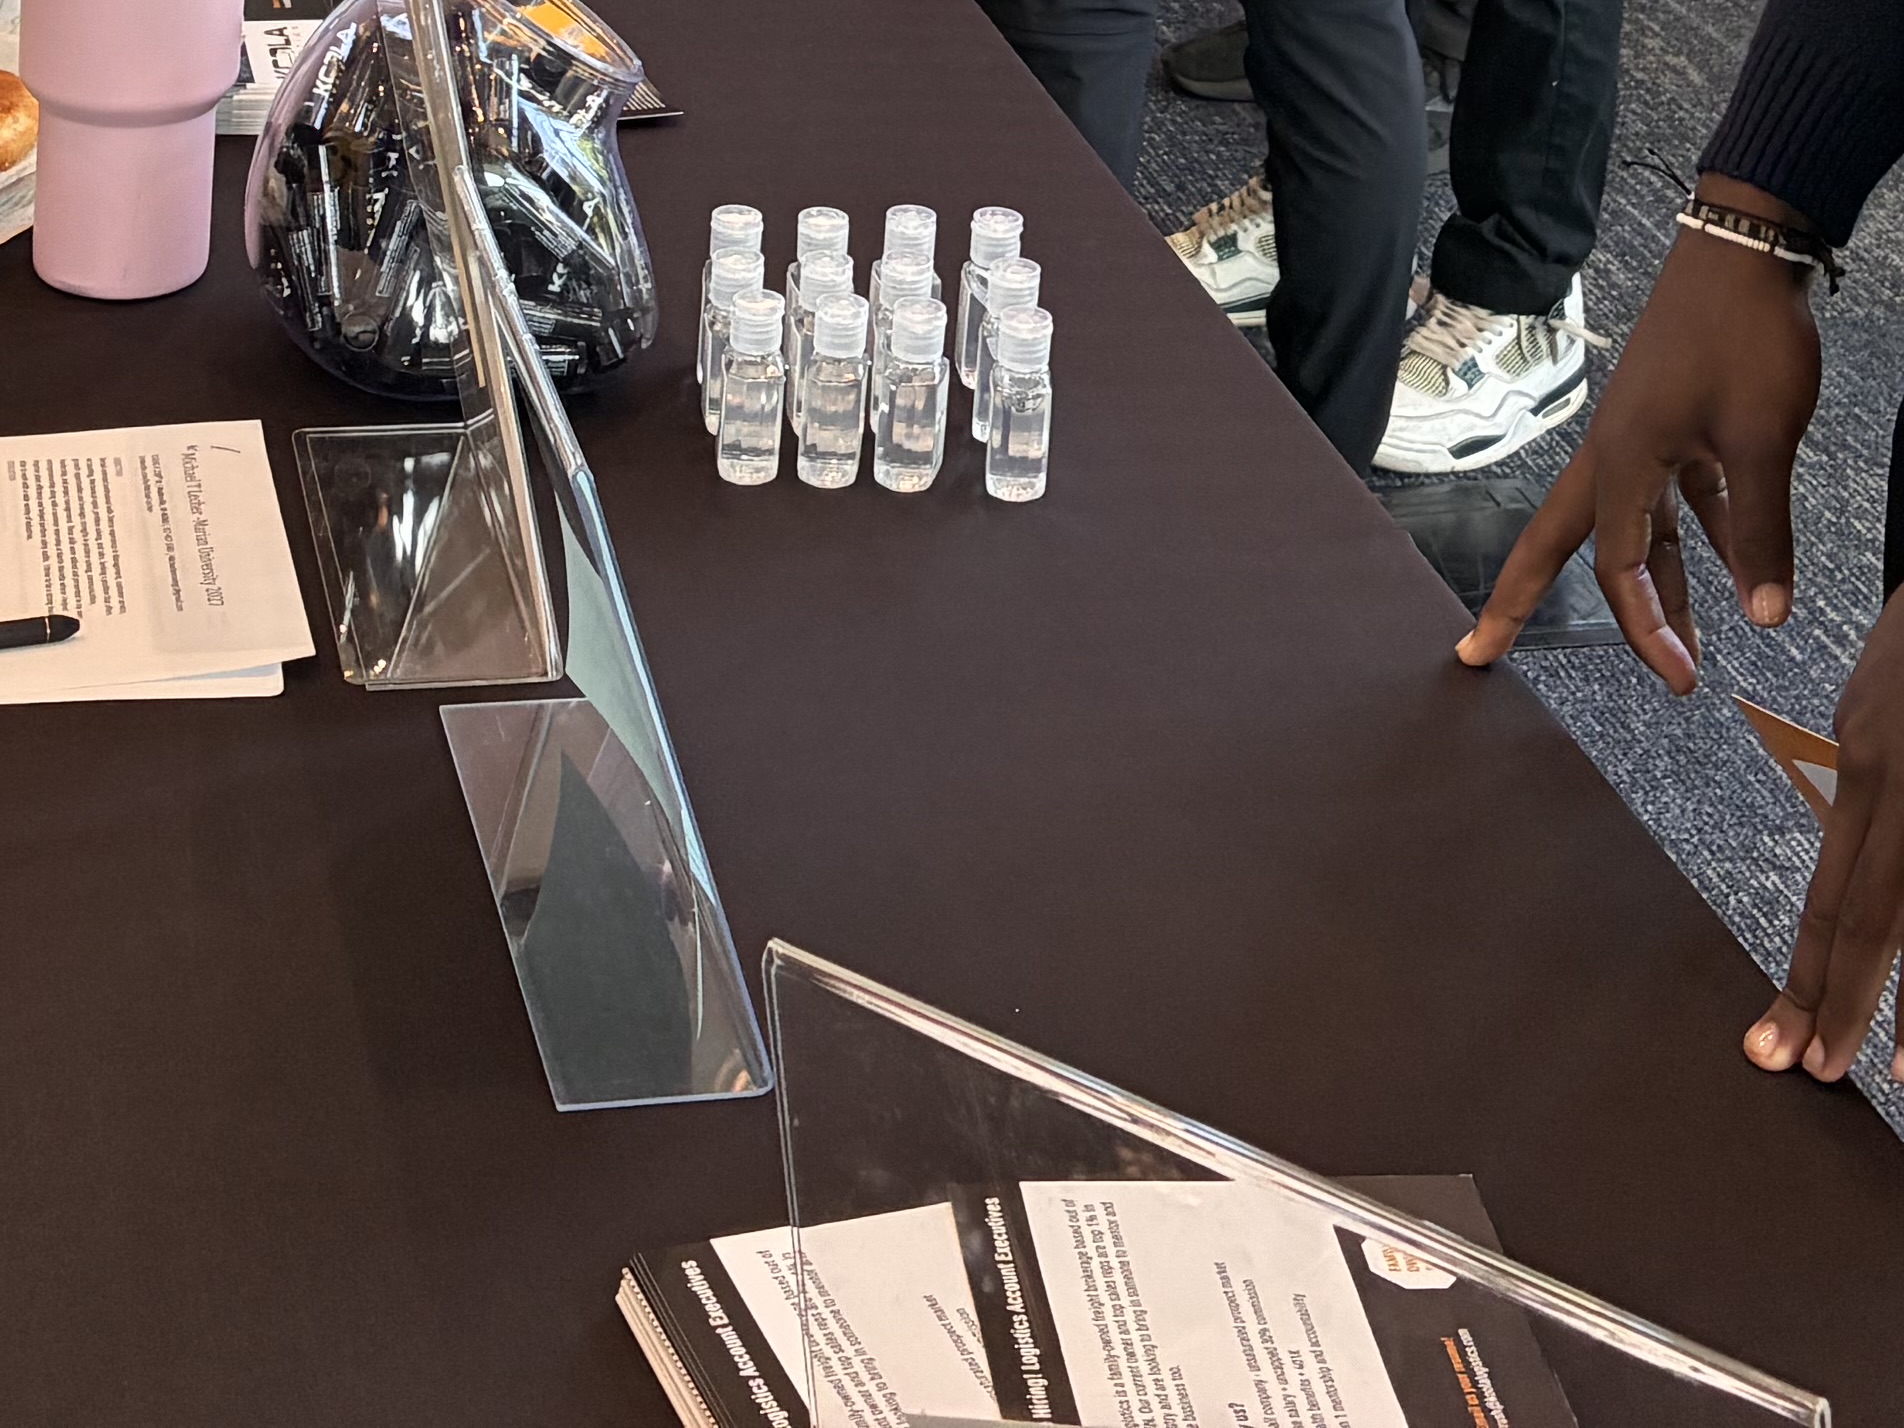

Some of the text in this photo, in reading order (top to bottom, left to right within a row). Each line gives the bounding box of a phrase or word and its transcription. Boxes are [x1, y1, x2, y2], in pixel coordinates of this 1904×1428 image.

[198, 547, 218, 586] University
[1060, 1199, 1076, 1207] of
[1082, 1204, 1096, 1212] in
[1064, 1209, 1080, 1223] out
[1085, 1215, 1099, 1226] 1%
[1068, 1225, 1086, 1249] based
[1091, 1230, 1105, 1243] top
[756, 1249, 772, 1258] of
[1096, 1245, 1108, 1258] are
[764, 1259, 782, 1274] out
[1077, 1251, 1098, 1292] brokerage
[1099, 1261, 1114, 1278] reps
[680, 1260, 729, 1326] Executives
[771, 1275, 800, 1300] based
[806, 1269, 831, 1297] mentor
[1105, 1280, 1120, 1301] sales
[823, 1298, 836, 1308] to
[984, 1197, 1052, 1418] Hiring! Logistics Account Executives
[1087, 1294, 1105, 1322] freight
[1099, 1201, 1172, 1410] and are looking to bring in someone to mentor and
[1112, 1304, 1127, 1317] top
[1242, 1279, 1268, 1325] commission
[810, 1312, 832, 1330] reps
[829, 1309, 862, 1347] someone
[923, 1294, 974, 1356] prospect market
[1113, 1320, 1131, 1335] and
[1292, 1293, 1321, 1347] accountability
[823, 1332, 845, 1354] sales
[1214, 1262, 1275, 1416] company unsaturated prospect market
[715, 1325, 759, 1376] Account
[854, 1347, 868, 1357] in
[1093, 1323, 1123, 1380] family-owned
[1309, 1350, 1327, 1364] and
[1440, 1337, 1466, 1372] resume!
[837, 1356, 854, 1370] top
[860, 1357, 883, 1381] bring
[1263, 1347, 1288, 1385] uncapped
[843, 1371, 866, 1388] and
[876, 1382, 888, 1392] to
[1317, 1366, 1345, 1411] mentorship
[1457, 1373, 1478, 1392] your
[1138, 1398, 1153, 1413] Our
[1174, 1384, 1196, 1421] business
[1282, 1394, 1300, 1418] salary
[1300, 1379, 1321, 1411] benefits
[1465, 1394, 1479, 1405] us
[1228, 1403, 1249, 1422] us?
